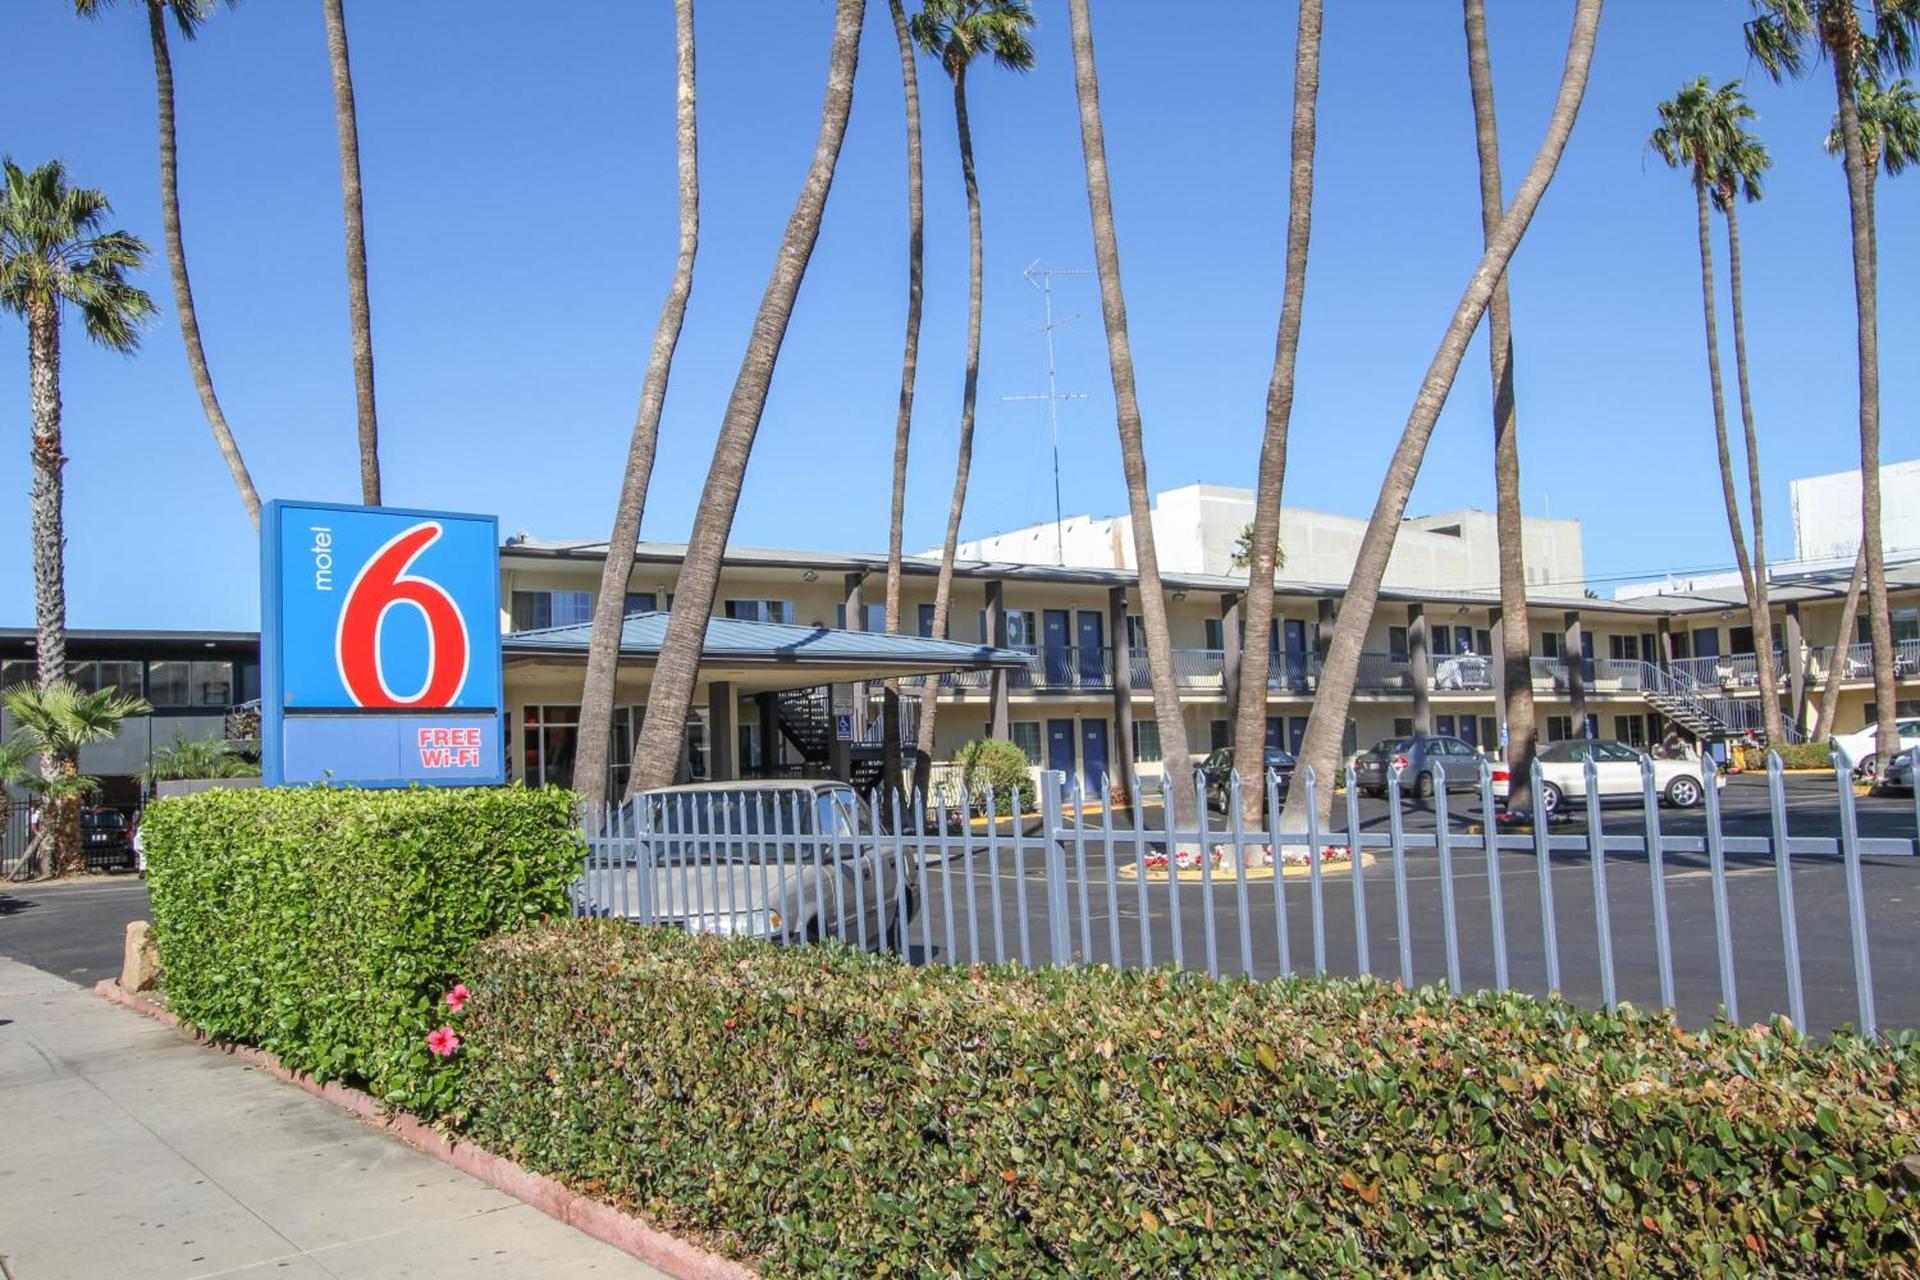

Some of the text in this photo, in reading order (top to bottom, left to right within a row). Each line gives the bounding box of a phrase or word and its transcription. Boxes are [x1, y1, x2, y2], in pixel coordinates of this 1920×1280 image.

[310, 527, 333, 591] motel
[335, 521, 470, 708] 6
[419, 728, 481, 747] FREE
[420, 748, 480, 768] Wi-Fi
